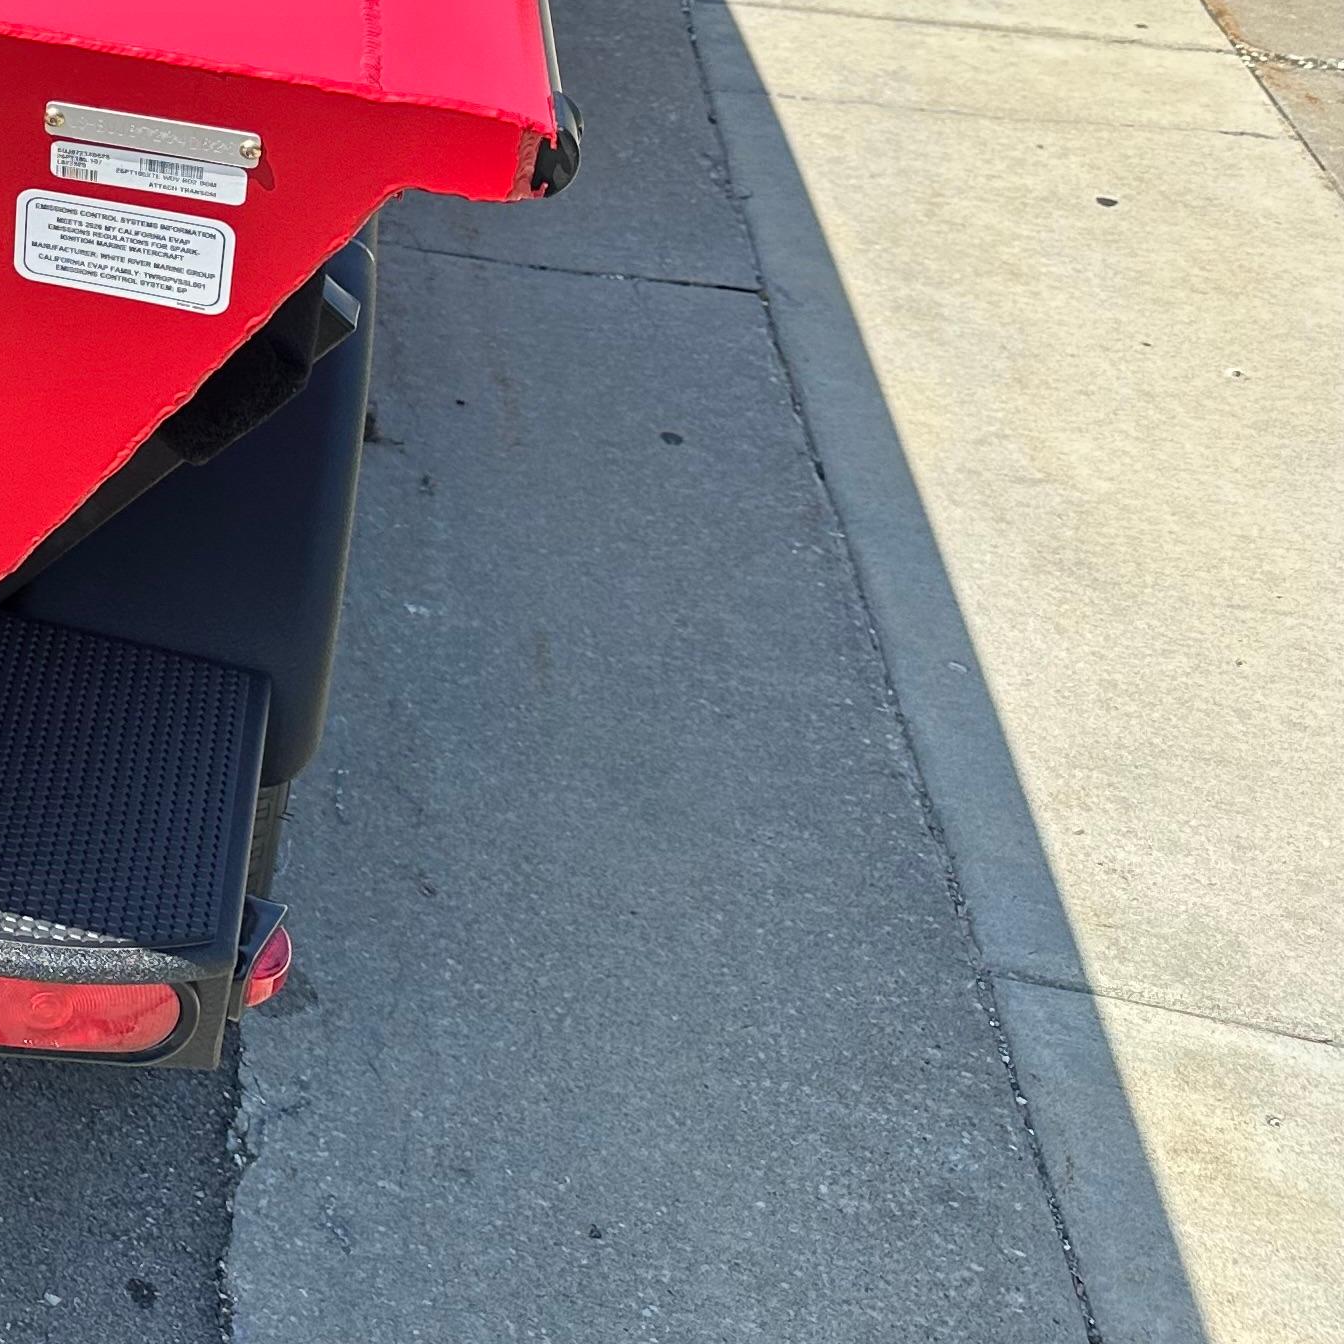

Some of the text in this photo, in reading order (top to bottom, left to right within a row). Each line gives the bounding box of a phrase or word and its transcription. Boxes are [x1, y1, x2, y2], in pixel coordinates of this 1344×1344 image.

[35, 202, 216, 240] EMISSIONS CONTROL SYSTEMS INFORMATION
[56, 216, 83, 226] MEETS
[117, 226, 167, 241] CALIFORNIA
[47, 222, 90, 236] EMISSIONS
[92, 230, 149, 246] REGULATIONS
[38, 252, 85, 267] CALIFORNIA
[60, 233, 184, 261] IGNITION MARINE WATERCRAFT
[55, 263, 98, 277] EMISSIONS
[99, 271, 137, 284] CONTROL
[100, 252, 125, 263] WHITE
[127, 257, 151, 268] RIVER
[153, 262, 184, 274] MARINE
[185, 268, 215, 280] GROUP
